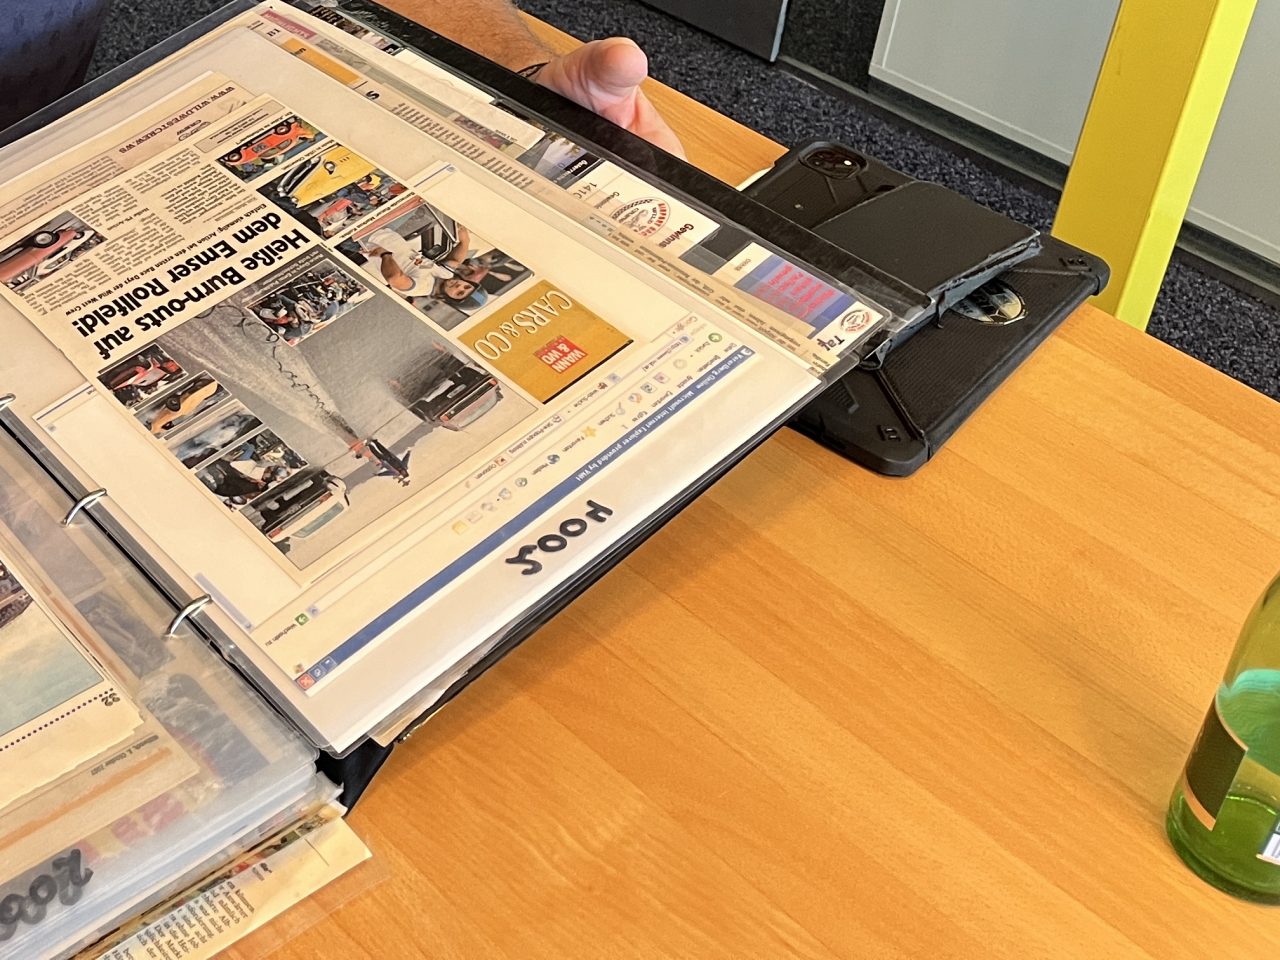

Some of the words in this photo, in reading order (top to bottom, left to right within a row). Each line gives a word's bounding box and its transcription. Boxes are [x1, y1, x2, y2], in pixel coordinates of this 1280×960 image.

[232, 212, 281, 243] dem
[167, 240, 236, 282] Emser
[240, 229, 309, 270] Heiße
[72, 278, 168, 336] Rollfeld!
[135, 266, 244, 330] Burn-outs
[512, 291, 573, 334] CARS
[93, 326, 133, 359] auf
[499, 323, 518, 338] &
[471, 331, 512, 360] CO
[541, 349, 563, 364] WO
[559, 344, 569, 352] &
[551, 349, 585, 372] WANN
[667, 390, 694, 411] Microsoft
[587, 462, 599, 470] by
[596, 443, 622, 465] provided
